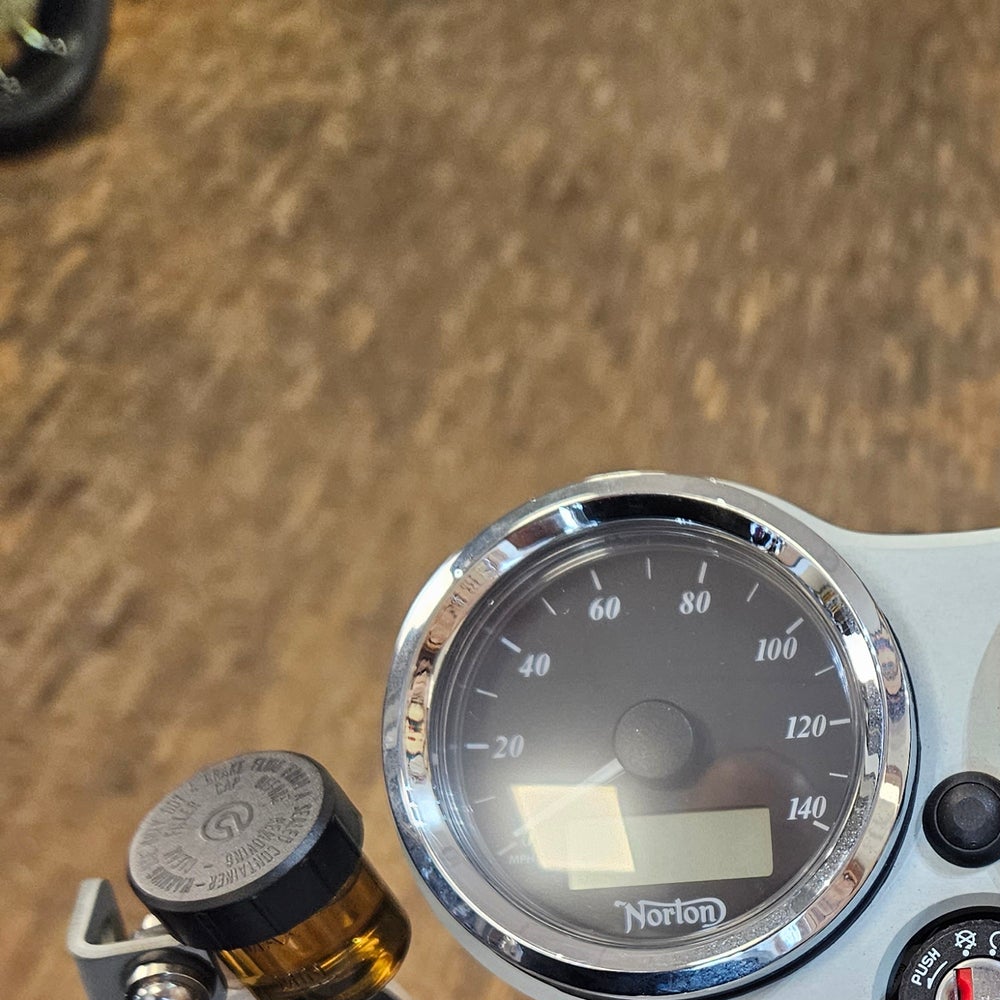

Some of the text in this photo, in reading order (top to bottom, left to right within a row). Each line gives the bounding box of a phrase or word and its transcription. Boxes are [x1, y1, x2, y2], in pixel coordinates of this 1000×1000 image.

[588, 597, 621, 622] 60
[679, 590, 712, 616] 80
[755, 637, 798, 662] 100
[519, 653, 551, 678] 40
[785, 714, 826, 740] 120
[494, 735, 525, 759] 20
[787, 796, 827, 821] 140
[208, 845, 281, 891] CONTAINER
[615, 897, 727, 934] Norton
[911, 947, 941, 986] PUSH
